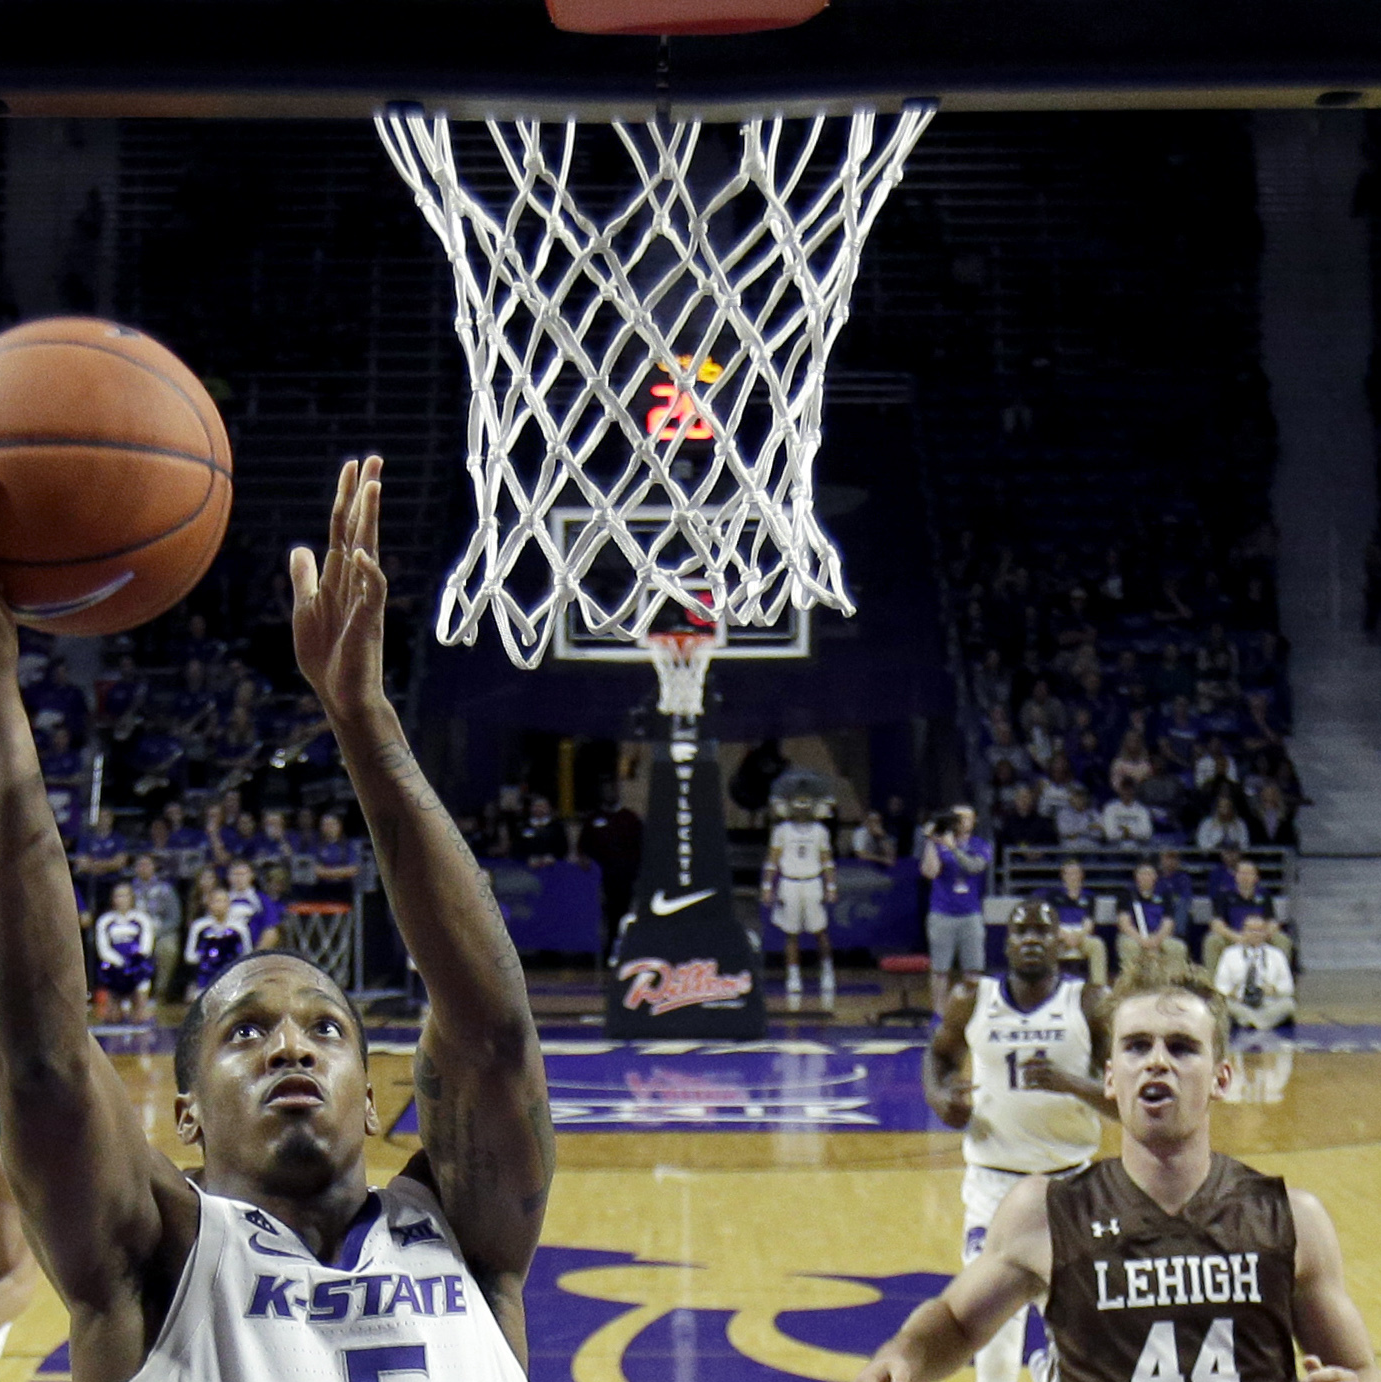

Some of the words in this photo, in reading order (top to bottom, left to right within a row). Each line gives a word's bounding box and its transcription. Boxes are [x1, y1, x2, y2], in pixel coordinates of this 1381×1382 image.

[989, 1029, 1065, 1042] K-STATE
[244, 1273, 468, 1323] K-STATE
[1094, 1252, 1262, 1311] LEHIGH
